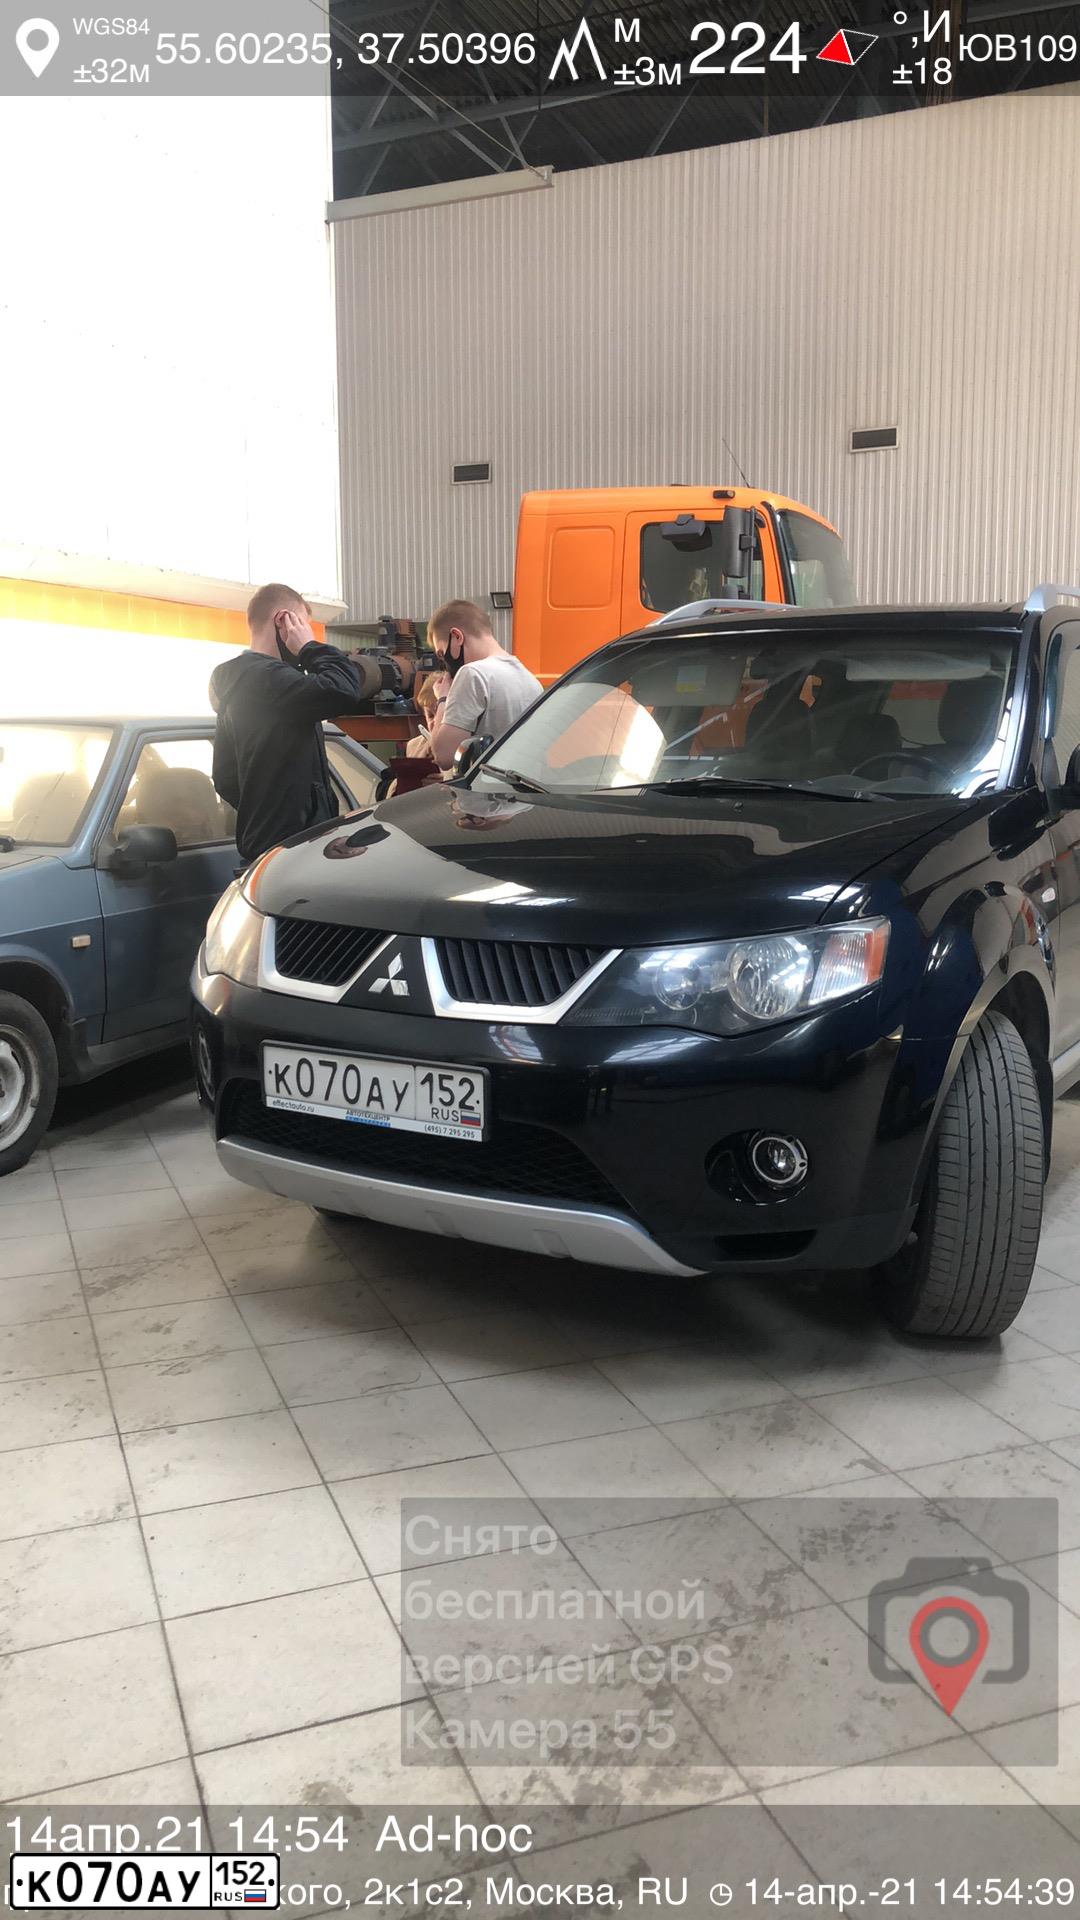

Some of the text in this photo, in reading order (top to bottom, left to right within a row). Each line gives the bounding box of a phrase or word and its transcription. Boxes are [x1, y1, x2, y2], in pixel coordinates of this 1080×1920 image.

[274, 1057, 475, 1112] К070АУ 152
[431, 1107, 460, 1122] RUS
